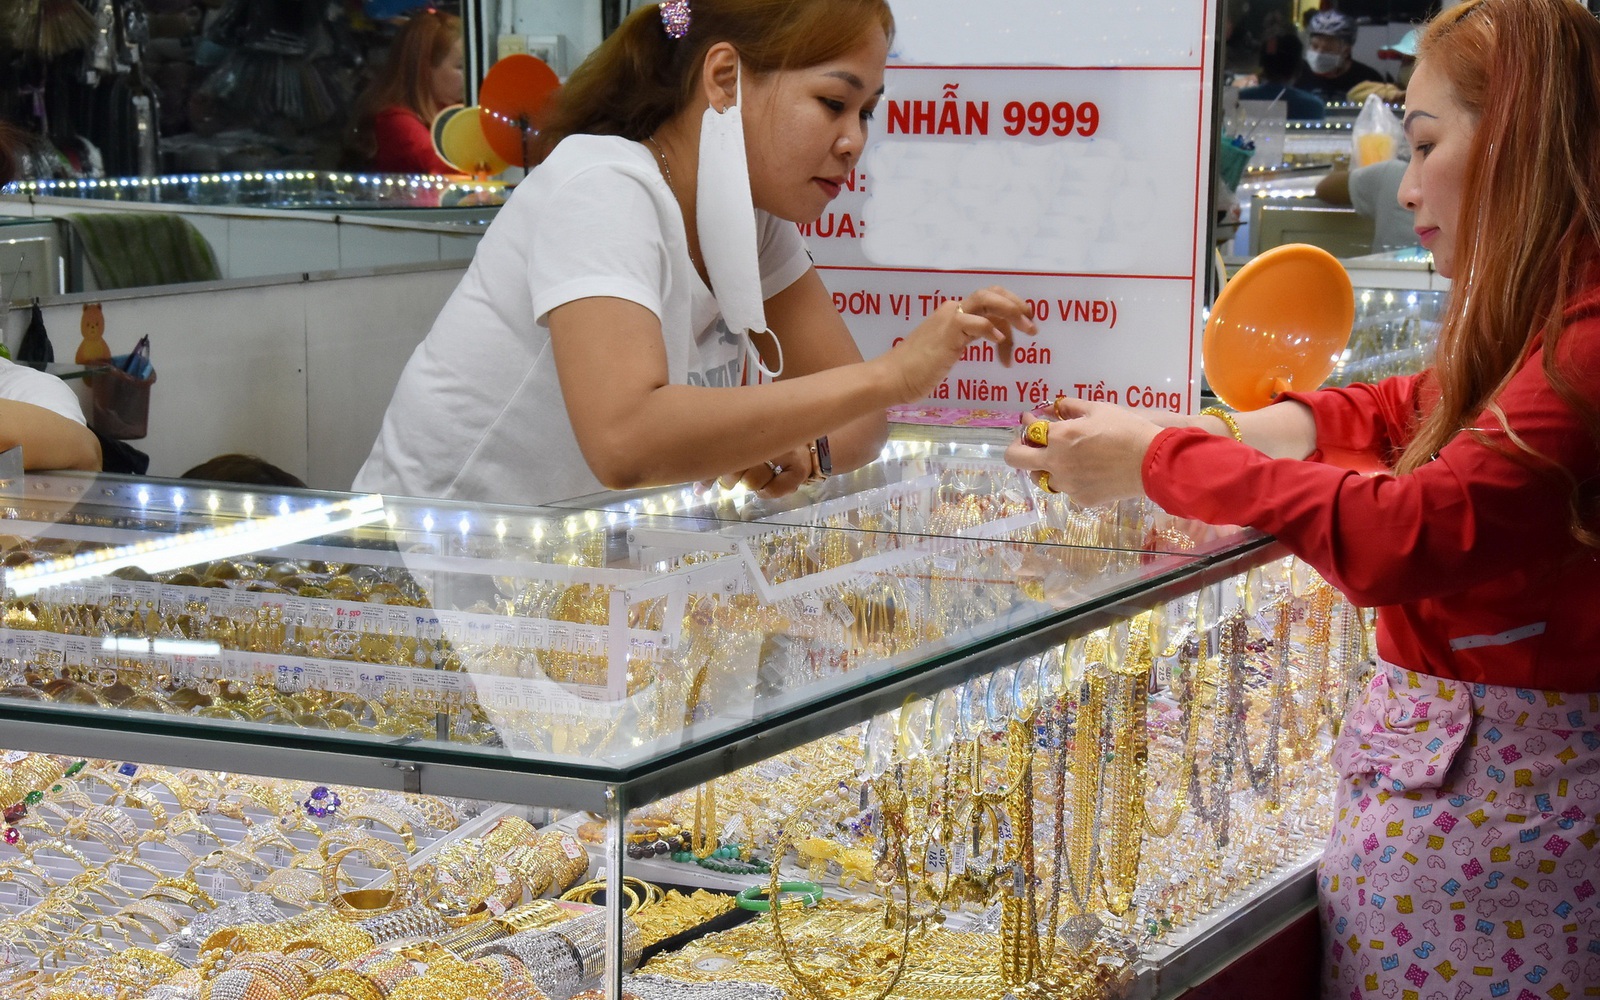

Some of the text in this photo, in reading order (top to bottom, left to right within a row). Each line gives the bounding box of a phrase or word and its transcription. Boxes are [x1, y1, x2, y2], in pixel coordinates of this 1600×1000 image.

[887, 83, 1099, 137] NHẪN 9999
[889, 294, 910, 321] VỊ
[1058, 300, 1117, 329] VNĐ)
[1014, 342, 1051, 364] oán
[957, 378, 1008, 402] Niêm
[1016, 378, 1049, 403] Yết
[1073, 380, 1118, 405] Tiền
[1126, 385, 1182, 413] Công
